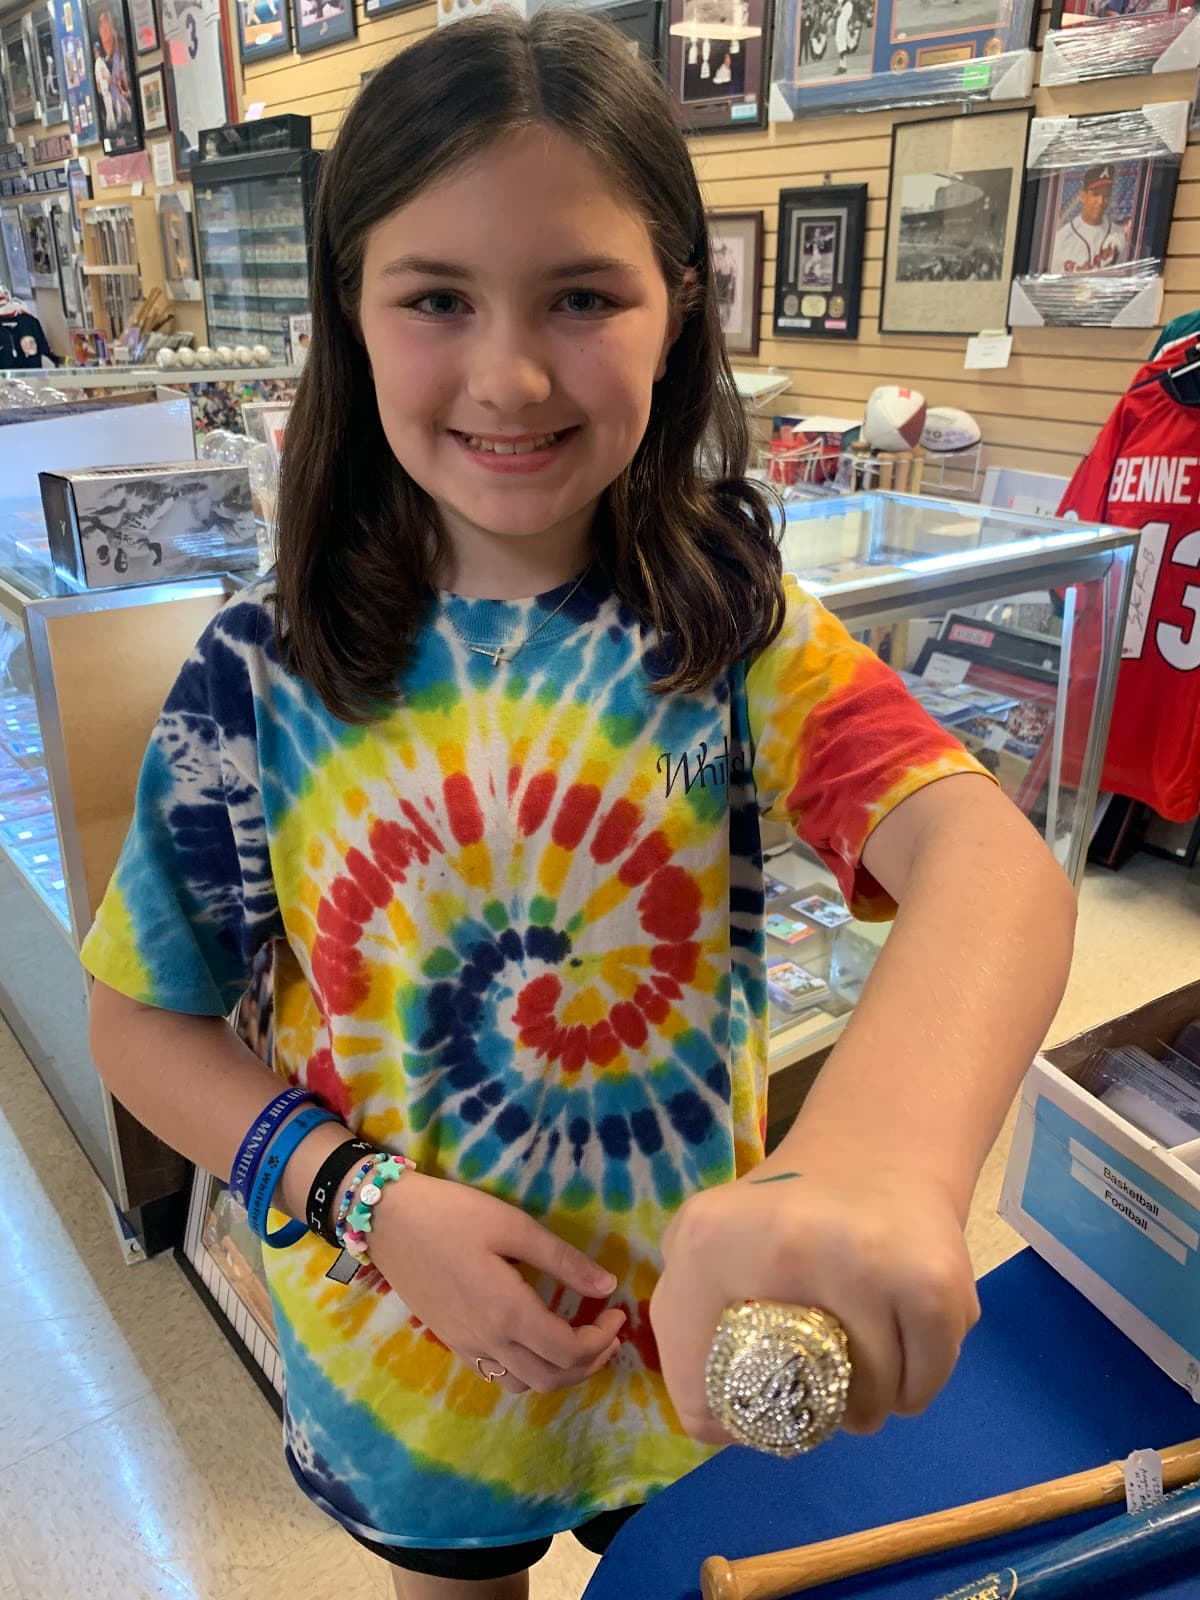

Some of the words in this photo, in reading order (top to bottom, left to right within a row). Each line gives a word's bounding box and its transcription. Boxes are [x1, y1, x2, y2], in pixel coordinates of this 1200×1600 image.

[185, 13, 199, 60] 3
[1103, 1167, 1160, 1217] Basketball
[1104, 1190, 1149, 1231] Football
